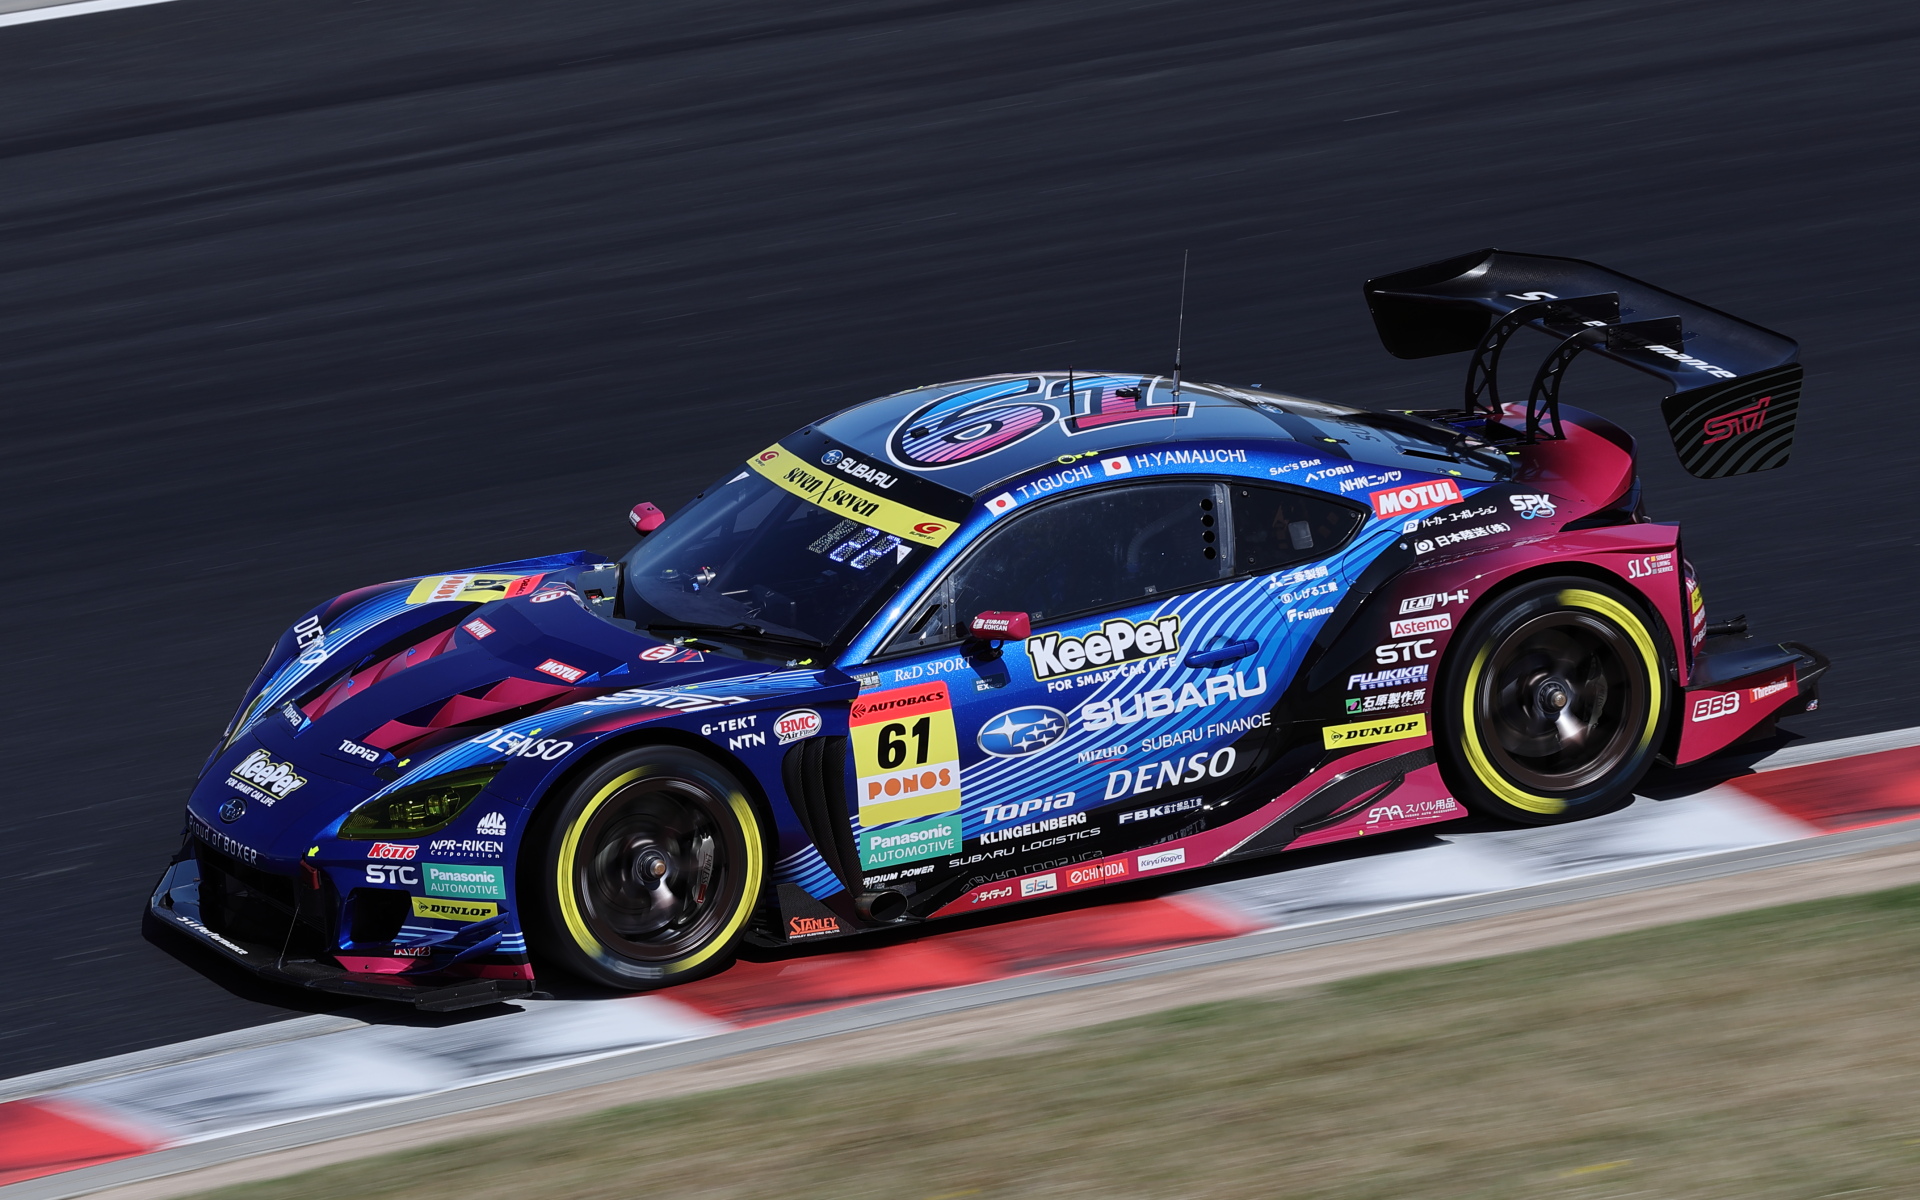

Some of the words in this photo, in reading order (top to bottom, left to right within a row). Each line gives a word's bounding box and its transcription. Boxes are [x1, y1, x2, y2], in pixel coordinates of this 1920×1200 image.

[886, 374, 1196, 471] 61
[1134, 449, 1248, 469] H.YAMAUCHI
[1299, 459, 1322, 469] BAR
[836, 457, 899, 489] SUBARU
[1016, 465, 1094, 500] T.IGUCHI
[1316, 465, 1355, 479] TORII
[783, 467, 823, 493] seven
[827, 489, 880, 517] seven
[1378, 482, 1458, 515] MOTUL
[1509, 494, 1558, 512] SPK
[1628, 557, 1652, 579] SLS
[1436, 589, 1470, 607] リード
[1297, 606, 1335, 621] Fujikura
[465, 620, 492, 639] MOTUL
[1394, 617, 1450, 636] Astemo
[1028, 616, 1180, 680] KeePer
[1375, 638, 1438, 665] STC
[539, 661, 583, 681] MOTUL
[894, 665, 924, 683] R&D
[926, 655, 974, 676] SPORT
[1047, 681, 1075, 694] FOR
[1077, 671, 1118, 689] SMART
[1120, 664, 1146, 679] CAR
[1149, 656, 1177, 672] LIFE
[1347, 664, 1430, 691] FUJIKIKAI
[867, 692, 944, 713] AUTOBACS
[1081, 666, 1268, 732] SUBARU
[1362, 688, 1427, 708] 石原製作所
[1692, 691, 1740, 722] BBS
[701, 714, 757, 736] G-TEKT
[779, 715, 816, 734] BMC
[1141, 727, 1203, 753] SUBARU
[1207, 712, 1272, 739] FINANCE
[1345, 721, 1419, 740] DUNLOP
[470, 727, 574, 761] DENSO
[729, 731, 766, 751] NTN
[877, 716, 931, 770] 61
[231, 749, 307, 799] KeePer
[868, 768, 951, 800] PONOS
[1103, 747, 1237, 801] DENSO
[225, 777, 236, 788] FOR
[234, 781, 254, 796] SMART
[250, 790, 263, 801] CAR
[260, 796, 276, 807] LIFE
[1118, 805, 1164, 825] FBK
[1406, 797, 1456, 813] スバル用品
[476, 812, 507, 829] MAC
[980, 812, 1087, 846] KLINGELNBERG
[476, 828, 506, 836] TOOLS
[870, 824, 952, 850] Panasonic
[211, 833, 222, 848] of
[223, 836, 257, 866] BOXER
[429, 840, 504, 853] NPR-RIKEN
[430, 851, 501, 859] Corporation
[868, 838, 955, 865] AUTOMOTIVE
[948, 846, 1016, 868] SUBARU
[1020, 827, 1101, 853] LOGISTICS
[1082, 861, 1125, 880] CHIYODA
[1140, 857, 1160, 868] Kiryu
[1159, 854, 1183, 866] Kogyo
[366, 864, 419, 885] STC
[429, 868, 496, 883] Panasonic
[863, 872, 899, 887] RIDIUM
[899, 865, 935, 879] POWER
[430, 883, 499, 895] AUTOMOTIVE
[979, 886, 1013, 902] ダイテック
[430, 904, 491, 916] DUNLOP
[789, 916, 840, 936] STANLEY
